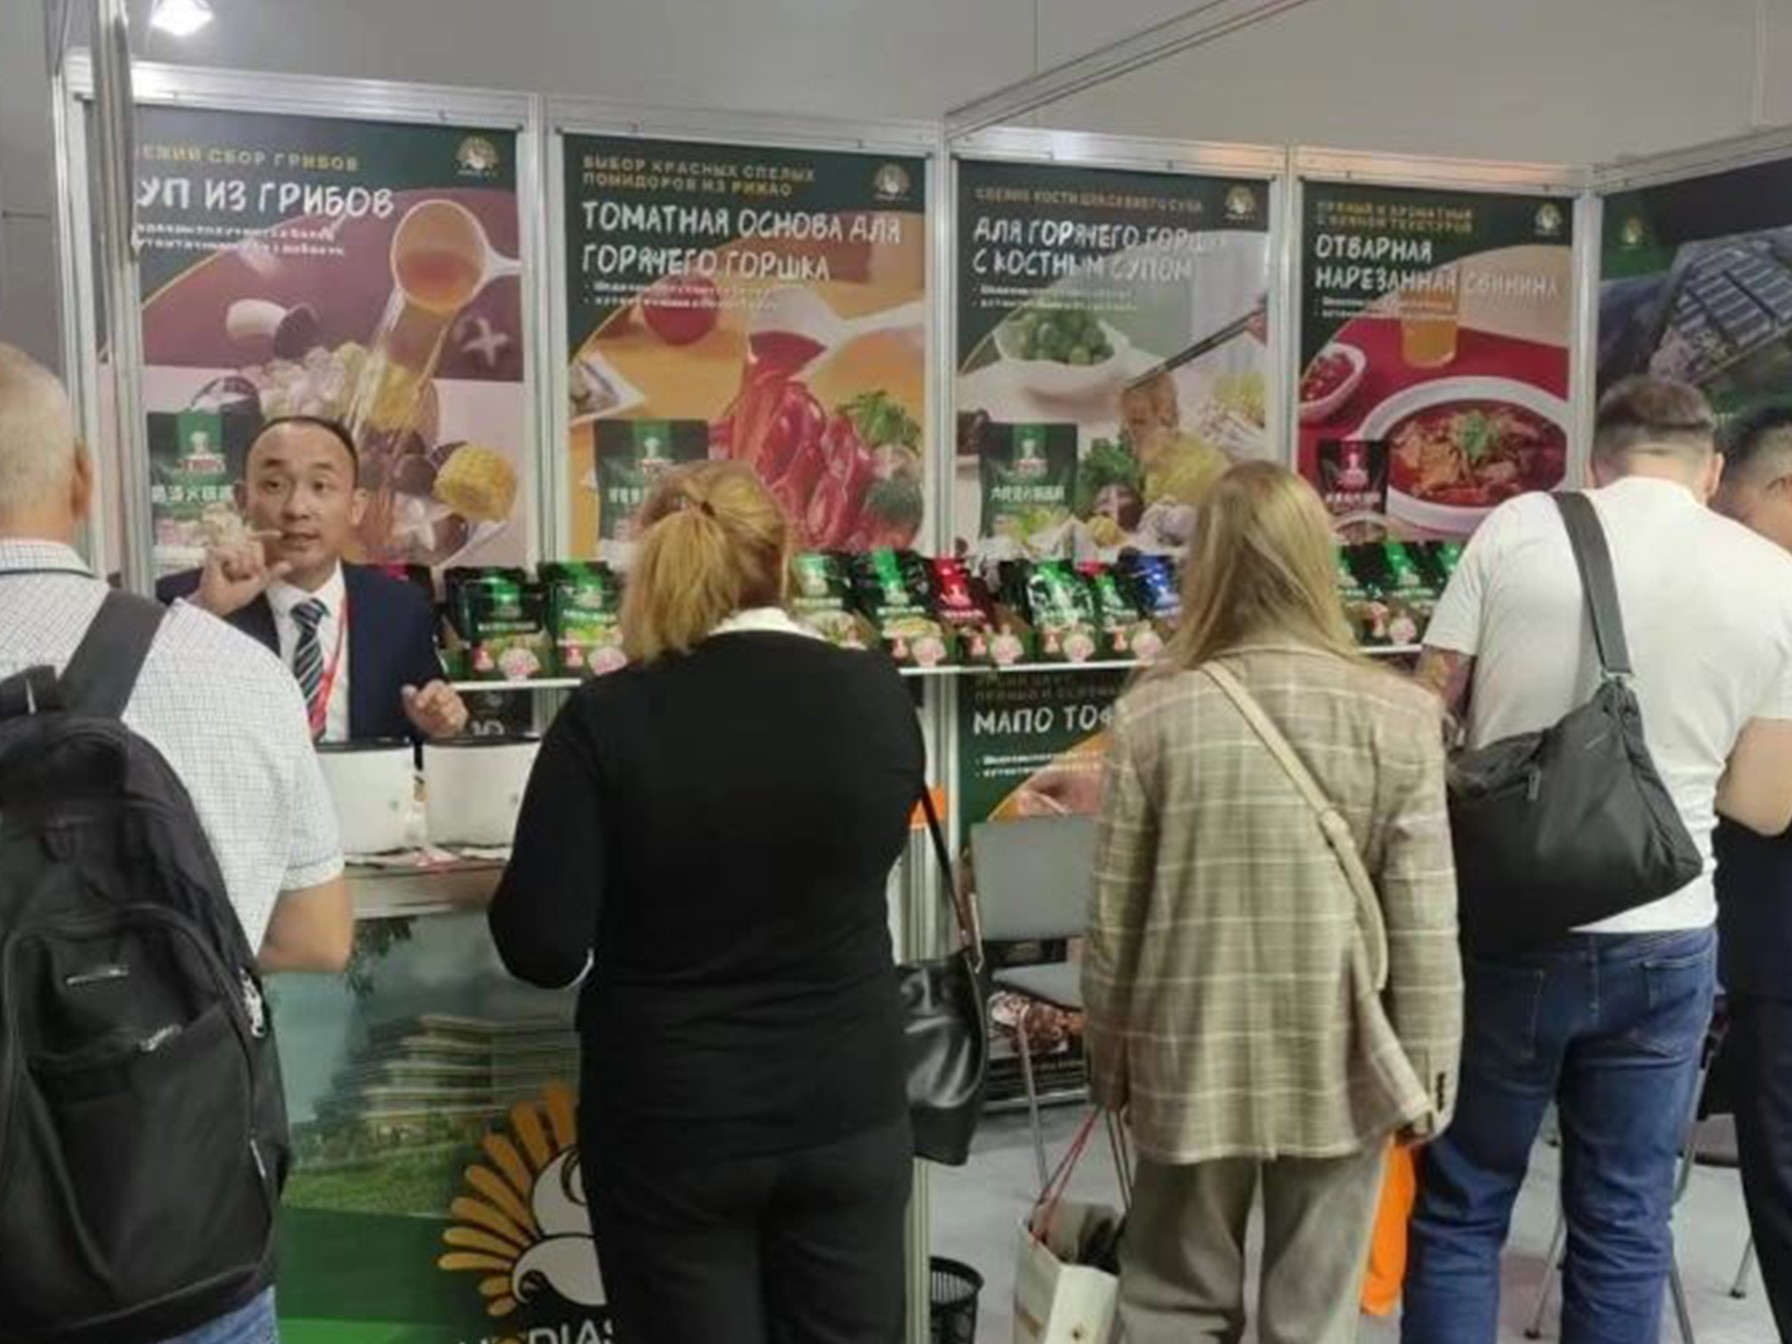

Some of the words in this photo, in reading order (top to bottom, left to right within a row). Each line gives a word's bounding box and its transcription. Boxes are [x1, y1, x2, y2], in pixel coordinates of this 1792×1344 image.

[273, 152, 359, 172] ГРИБОВ
[583, 155, 646, 172] ВЫБОР
[650, 160, 738, 178] КРАСНЫХ
[742, 164, 816, 181] СПЕЛЫХ
[583, 172, 697, 191] ПОМИДОРОВ
[136, 178, 191, 209] УП
[205, 179, 246, 212] ИЗ
[258, 182, 395, 218] ГРИБОВ
[582, 201, 730, 236] ТОМАТНАЯ
[737, 209, 843, 242] ОСНОВА
[849, 215, 901, 244] ДЛЯ
[974, 216, 1022, 244] ДЛЯ
[1027, 219, 1140, 250] ГОРЯЧЕГО
[582, 245, 718, 277] ГОРЯЧЕГО
[725, 251, 830, 281] ГОРШКА
[972, 248, 988, 274] С
[994, 251, 1105, 277] КОСТНЫМ
[1112, 257, 1193, 281] СУПОМ
[1315, 234, 1432, 264] ОТВАРНАЯ
[1315, 267, 1456, 295] НАРЕЗАННАЯ
[973, 706, 1054, 735] МАПО
[1063, 704, 1114, 731] ТОФ
